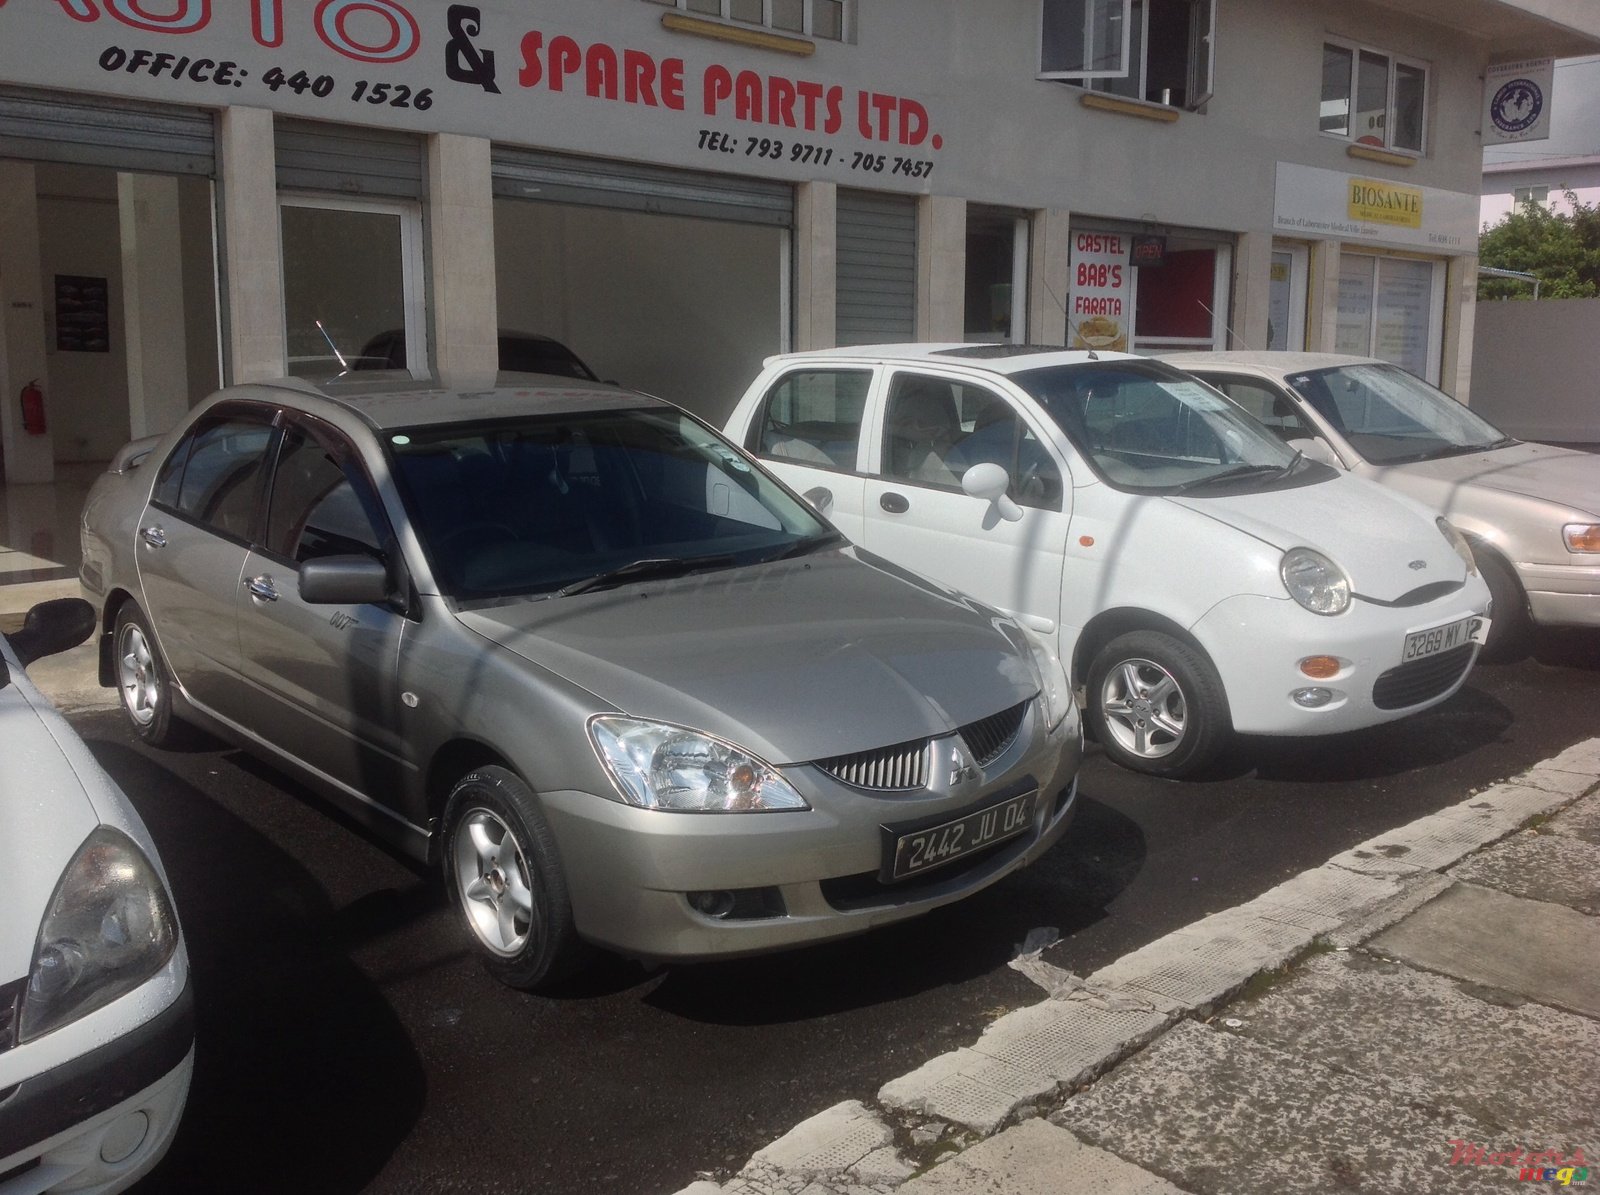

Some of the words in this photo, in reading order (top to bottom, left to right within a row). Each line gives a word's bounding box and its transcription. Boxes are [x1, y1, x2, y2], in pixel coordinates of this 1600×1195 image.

[446, 4, 501, 94] &
[99, 46, 249, 88] OFFICE:
[262, 66, 335, 98] 440
[351, 79, 434, 111] 1526
[519, 30, 685, 111] SPARE
[703, 63, 843, 135] PARTS
[857, 90, 943, 150] LTD.
[698, 130, 738, 154] TEL:
[745, 136, 783, 161] 793
[789, 142, 833, 167] 9711
[851, 150, 885, 173] 705
[891, 157, 934, 179] 7457
[1352, 185, 1419, 213] BIOSANTE
[1277, 215, 1296, 226] Branch
[1296, 218, 1302, 226] of
[1077, 233, 1124, 254] CASTEL
[1077, 262, 1122, 288] BAB'S
[1075, 296, 1122, 315] FARATA
[1465, 618, 1483, 641] 12
[909, 823, 965, 869] 2442
[971, 810, 998, 845] JU
[1004, 799, 1026, 832] 04
